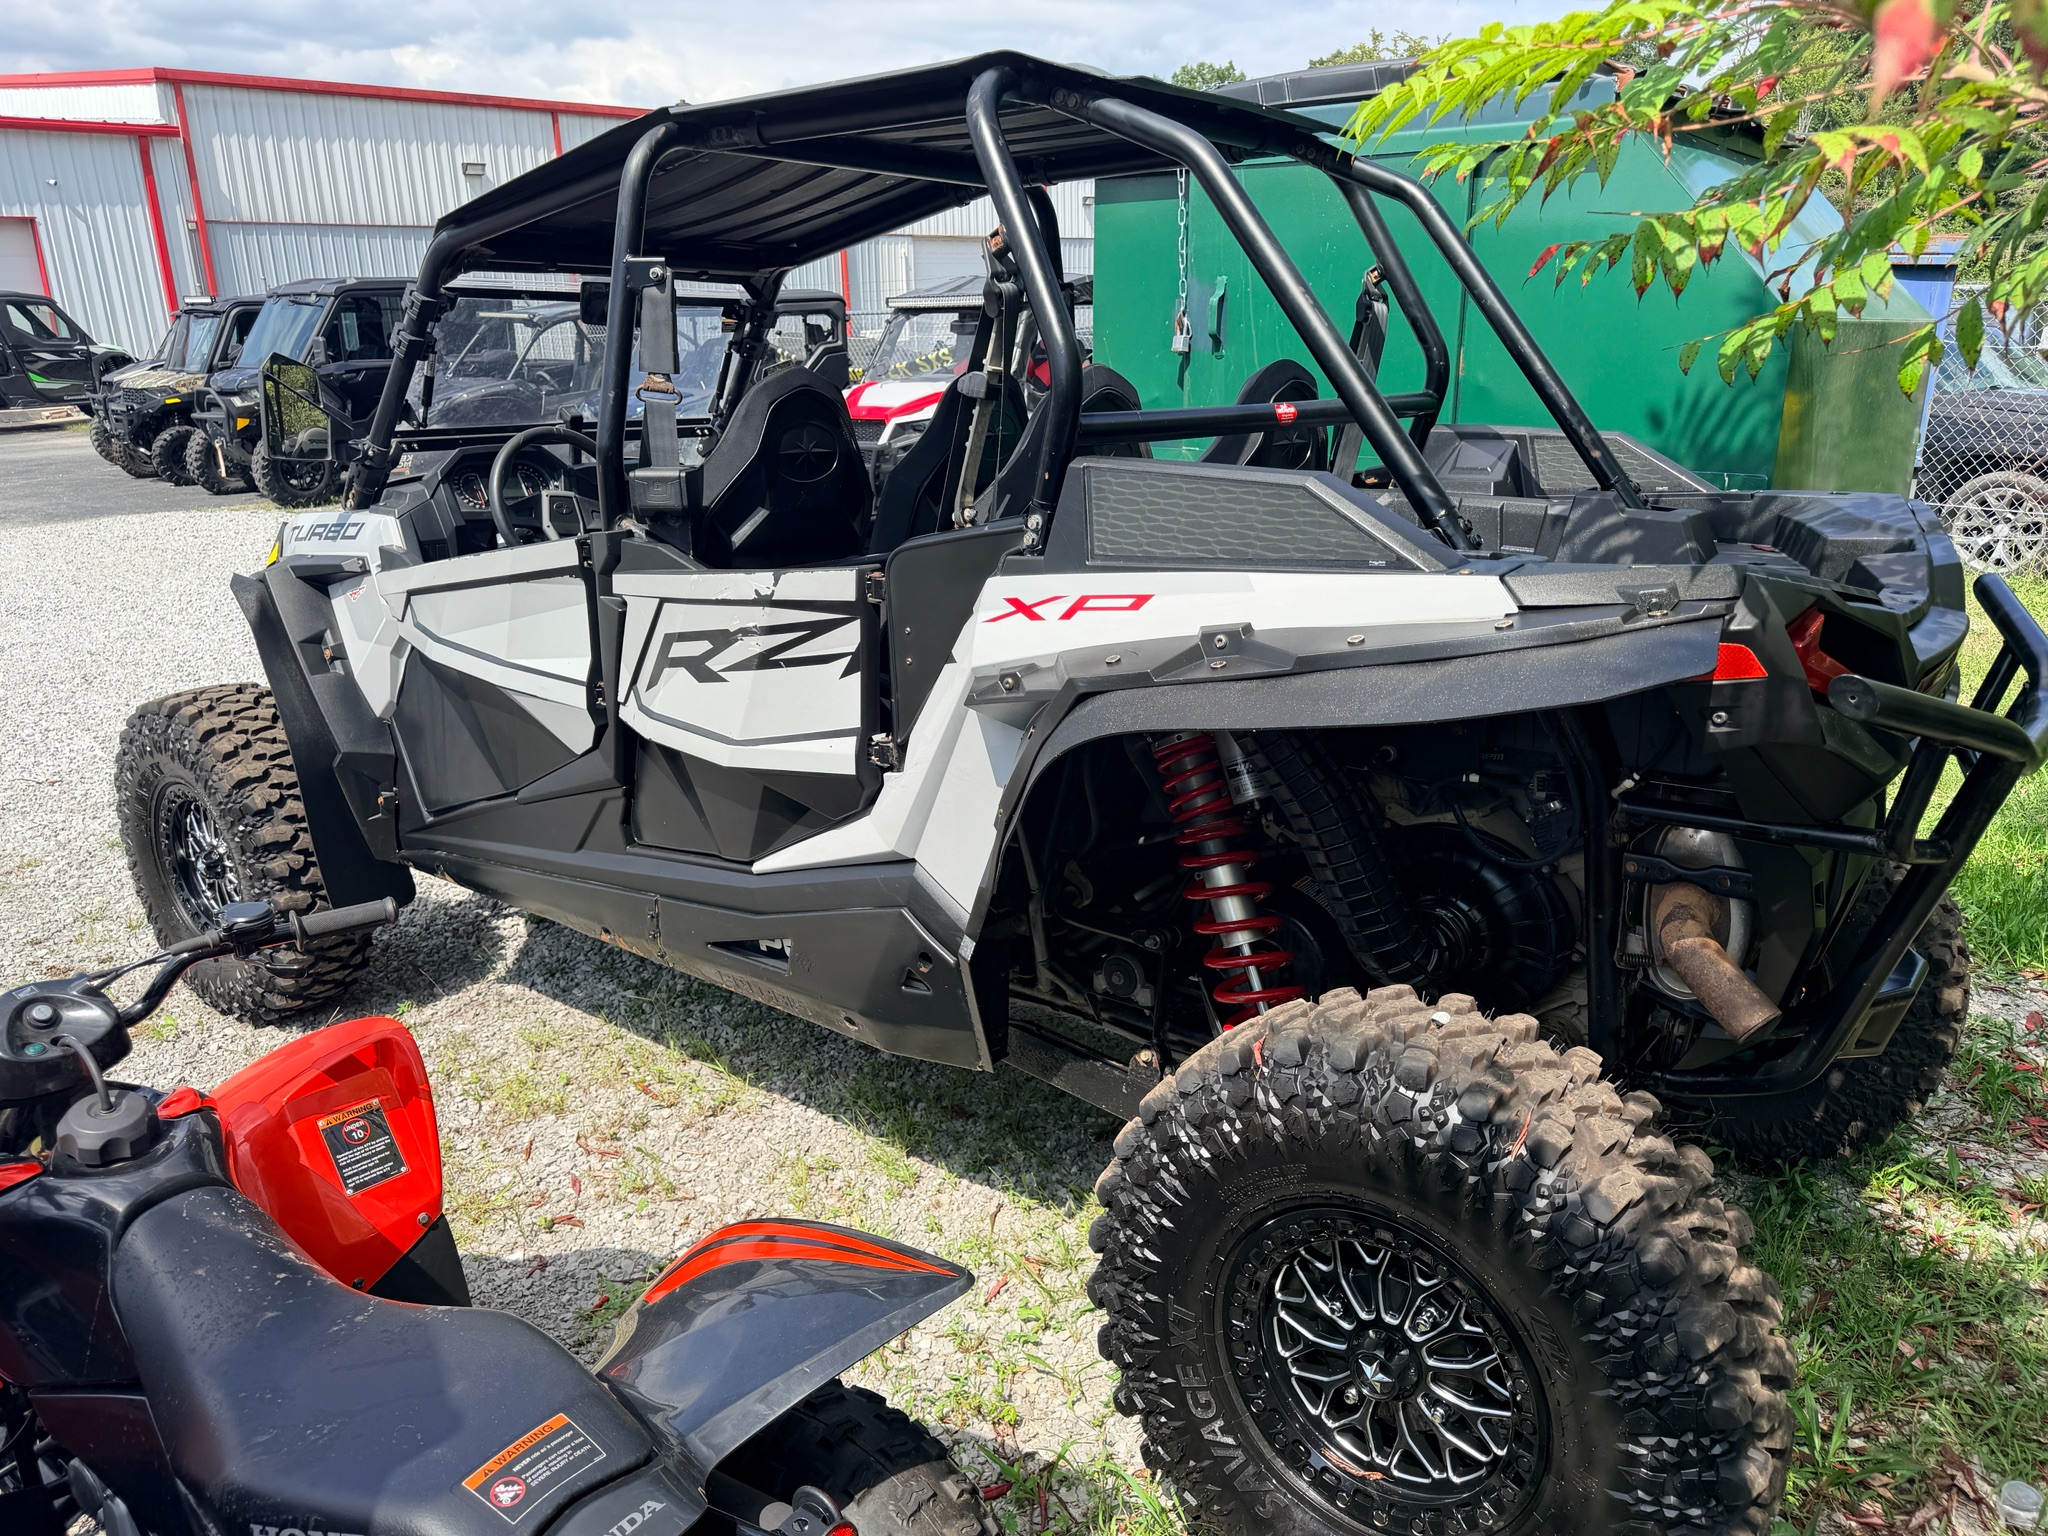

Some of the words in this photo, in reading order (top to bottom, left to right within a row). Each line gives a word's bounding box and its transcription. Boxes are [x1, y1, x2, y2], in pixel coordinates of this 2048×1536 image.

[289, 522, 365, 544] TURBO
[981, 594, 1156, 623] XP
[645, 616, 861, 692] RZ
[332, 1103, 373, 1122] WARNING
[344, 1120, 365, 1132] UNDER
[351, 1129, 364, 1140] 10
[1167, 1293, 1201, 1357] XT
[493, 1424, 554, 1466] WARNING
[512, 1458, 531, 1472] NEVER
[550, 1430, 573, 1446] passenger
[1176, 1363, 1289, 1519] SAVAGE
[521, 1459, 548, 1479] Passengers
[557, 1445, 570, 1454] cause
[530, 1470, 551, 1486] SEVERE
[551, 1458, 568, 1472] INJURY
[574, 1445, 591, 1456] DEATH
[548, 1453, 568, 1467] resulting
[603, 1500, 666, 1536] NDA
